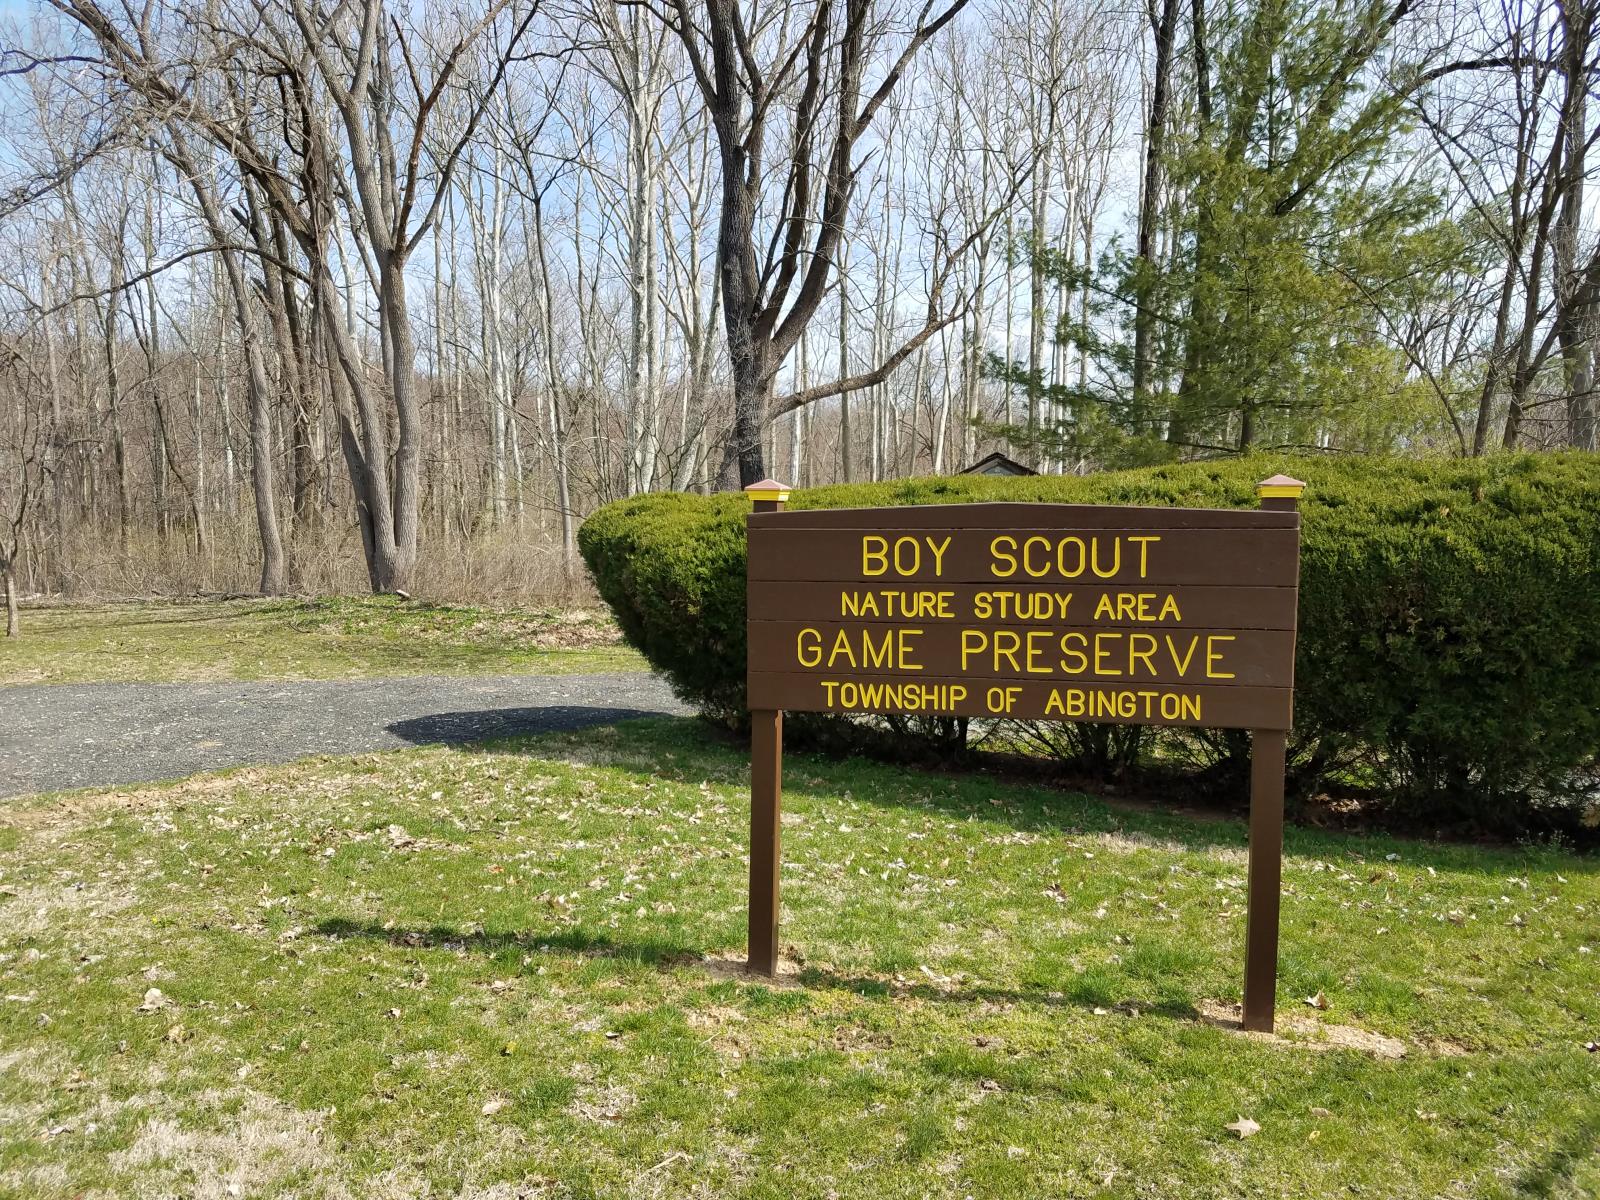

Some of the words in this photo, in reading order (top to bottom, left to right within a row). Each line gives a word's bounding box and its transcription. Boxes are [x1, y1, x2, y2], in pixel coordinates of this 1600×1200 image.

[861, 535, 953, 578] BOY
[989, 535, 1162, 579] SCOUT
[840, 591, 956, 619] NATURE
[973, 591, 1074, 620] STUDY
[1092, 592, 1183, 622] AREA
[796, 628, 925, 670] GAME
[960, 629, 1237, 679] PRESERVE
[820, 681, 968, 712] TOWNSHIP
[986, 687, 1023, 714] OF
[1043, 688, 1202, 722] ABINGTON
